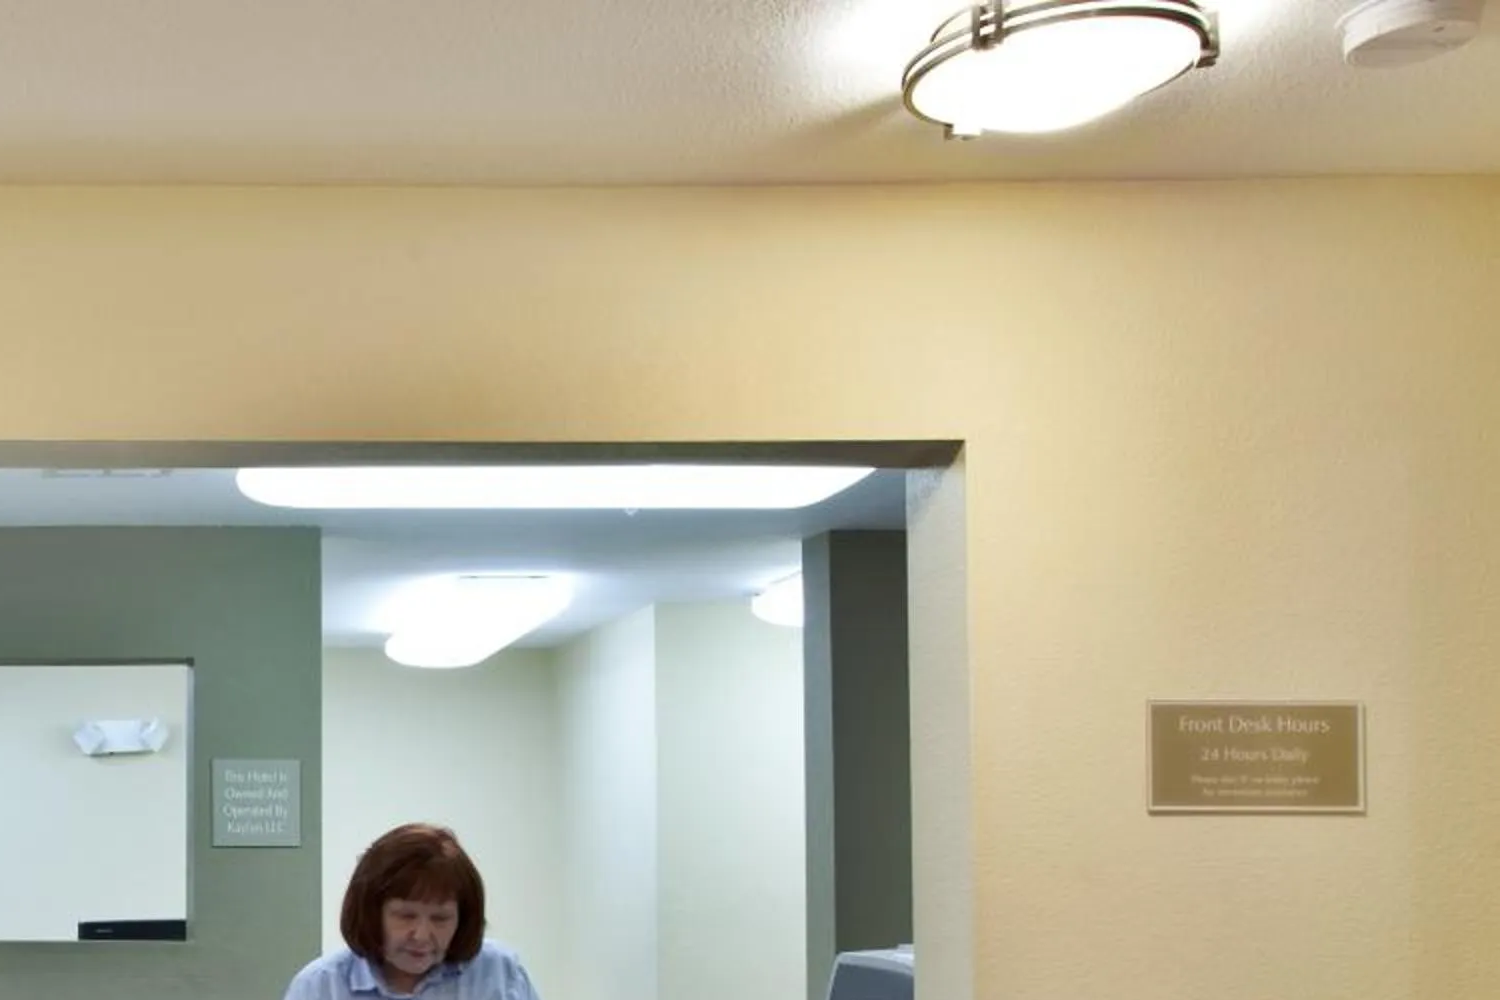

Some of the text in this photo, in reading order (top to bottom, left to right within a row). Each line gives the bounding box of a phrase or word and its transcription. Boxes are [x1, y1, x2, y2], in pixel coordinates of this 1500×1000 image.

[1178, 715, 1331, 733] Front Desk Hours
[1201, 748, 1219, 761] 24
[1223, 747, 1269, 762] Hours
